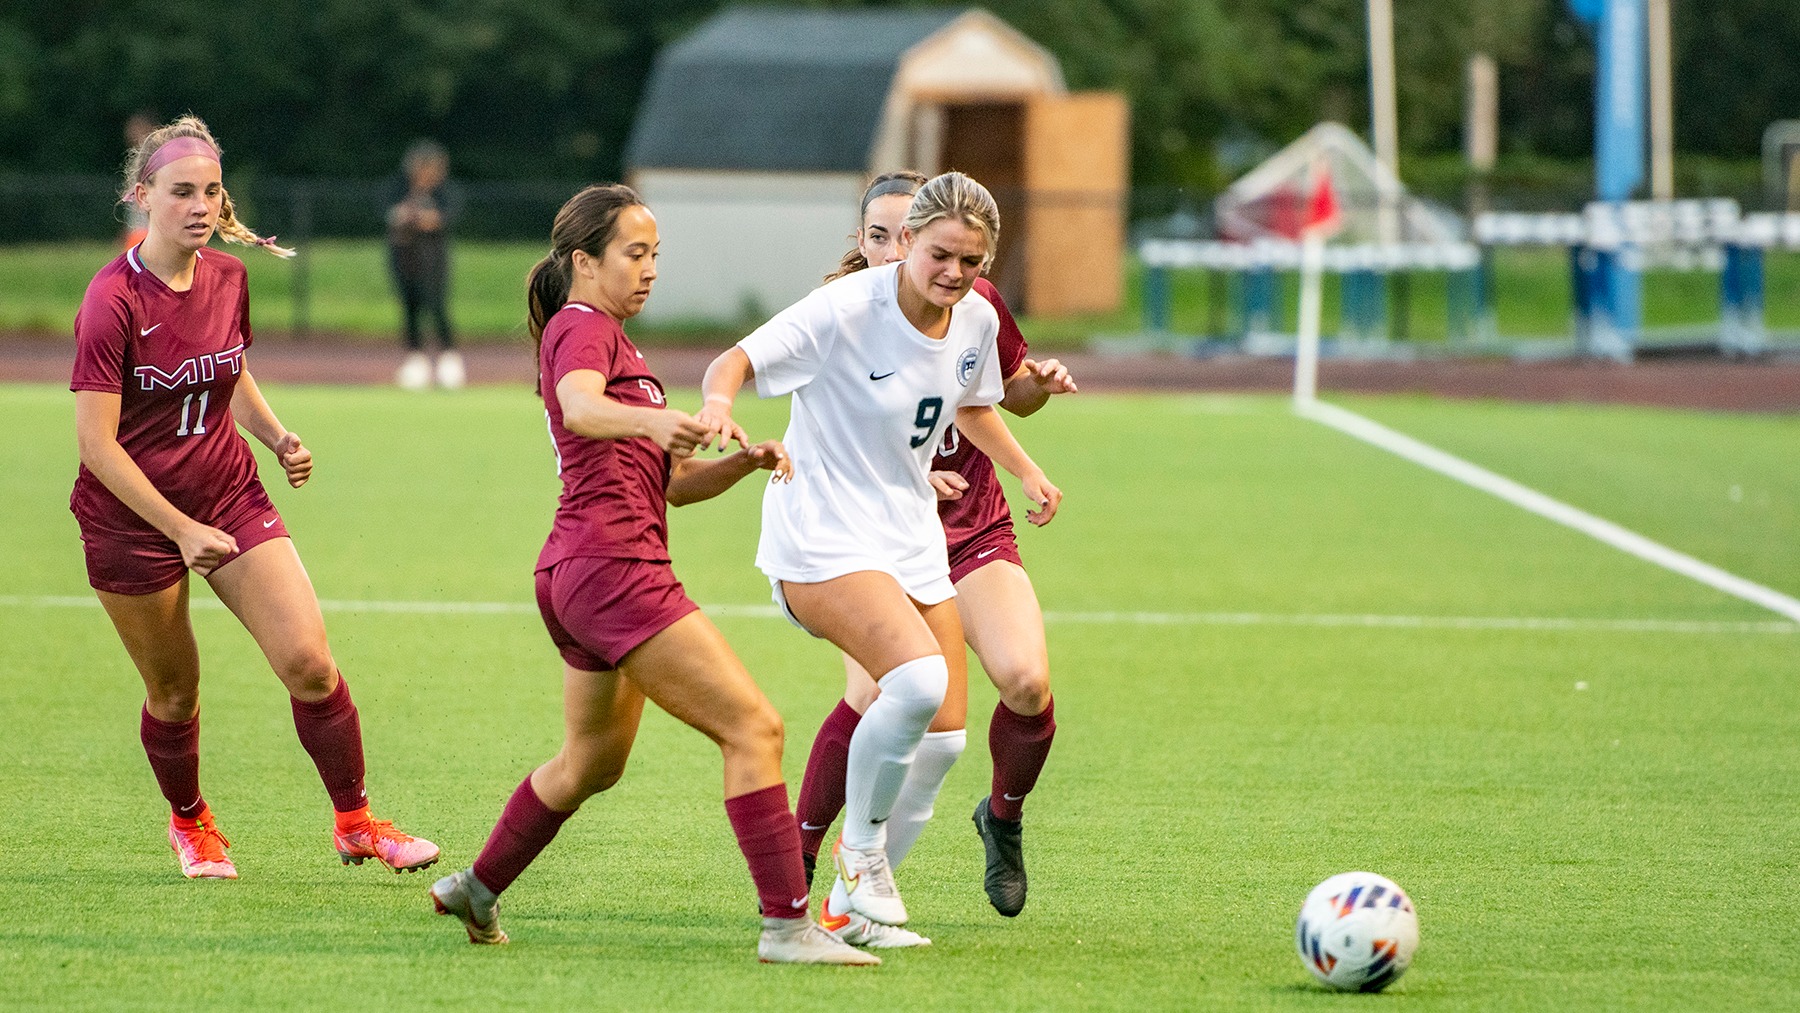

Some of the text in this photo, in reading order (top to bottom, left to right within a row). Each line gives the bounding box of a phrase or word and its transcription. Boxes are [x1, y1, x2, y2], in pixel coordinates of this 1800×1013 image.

[133, 343, 245, 391] MIT
[176, 390, 210, 437] 11
[909, 396, 944, 450] 9
